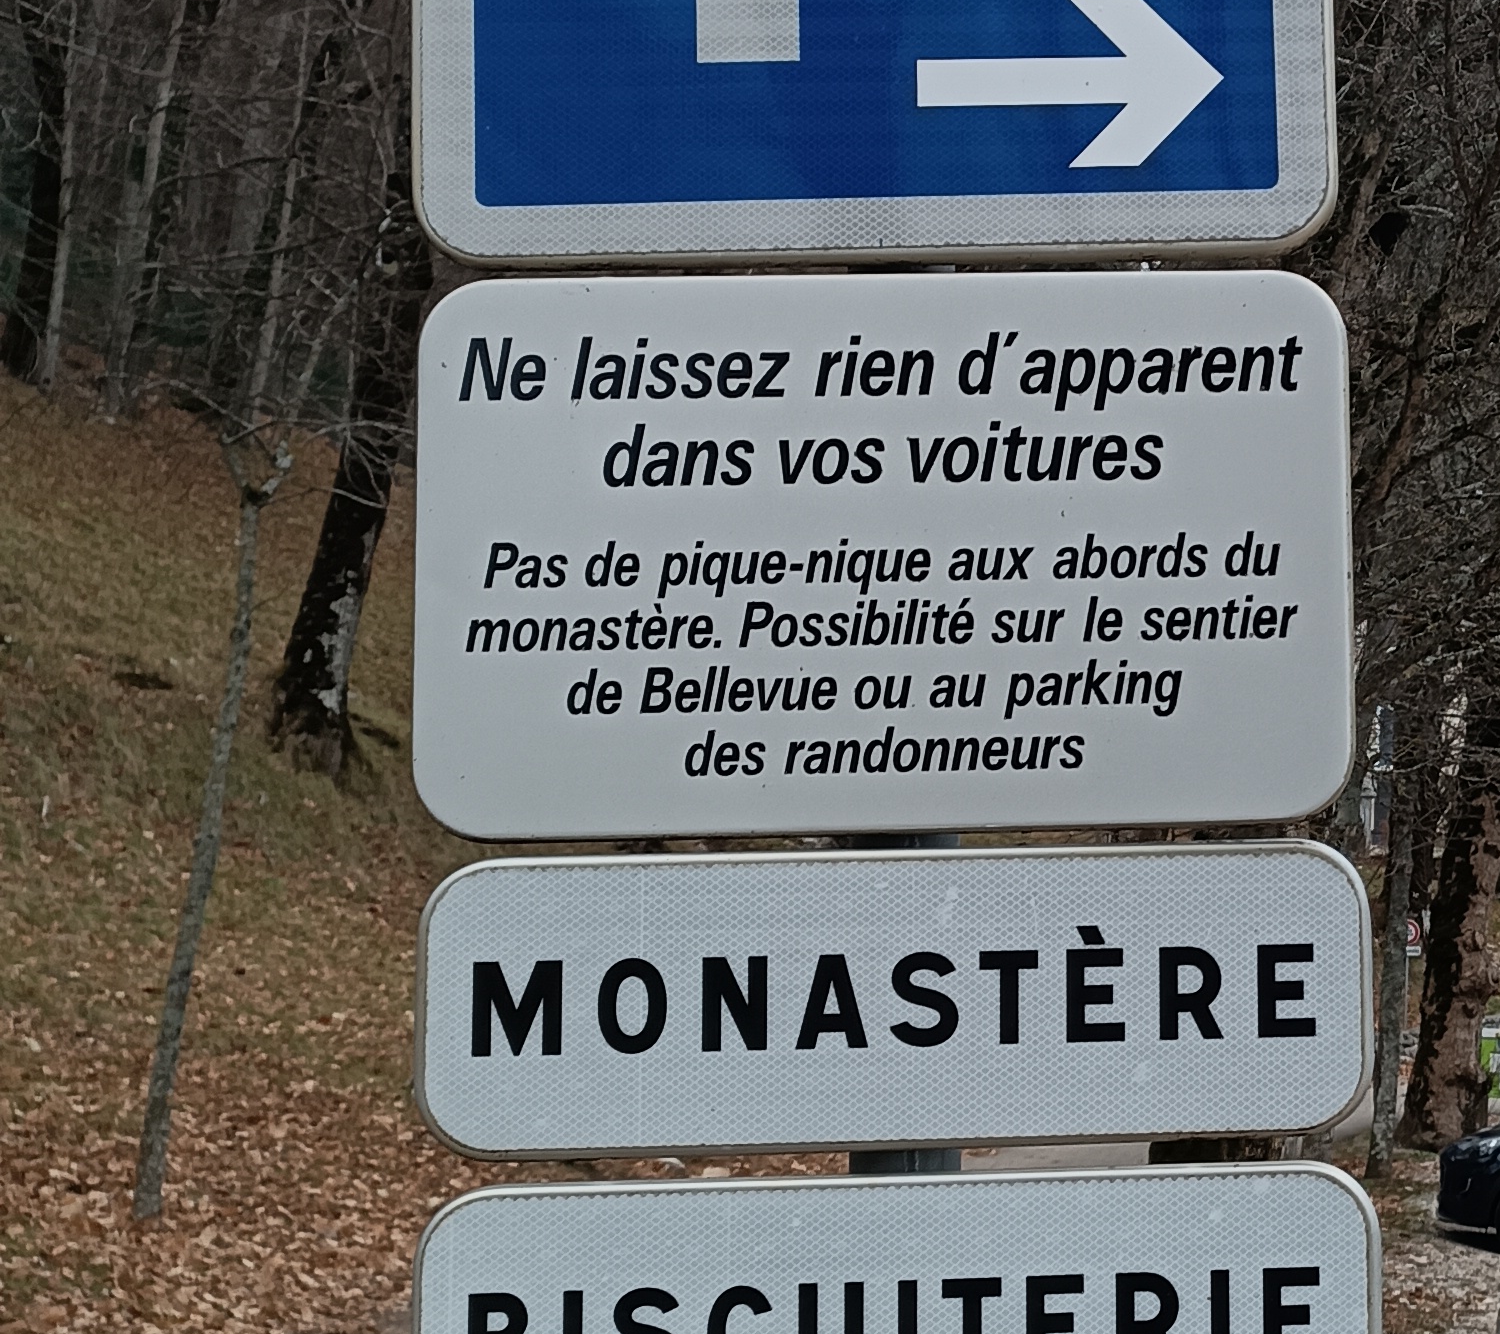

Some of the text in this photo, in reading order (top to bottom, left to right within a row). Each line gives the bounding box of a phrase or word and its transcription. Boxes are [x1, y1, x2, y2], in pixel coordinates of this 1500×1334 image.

[458, 336, 547, 402] Ne
[570, 336, 791, 401] laissez
[814, 334, 935, 397] rien
[602, 420, 1164, 488] dans vos voitures
[483, 530, 1281, 599] Pas de pique-nique aux abords du
[465, 594, 1299, 653] monastère. Possibilité sur le sentier
[566, 658, 1183, 720] de Bellevue ou au parking
[684, 725, 1085, 777] des randonneurs
[470, 924, 1317, 1058] MONASTÈRE
